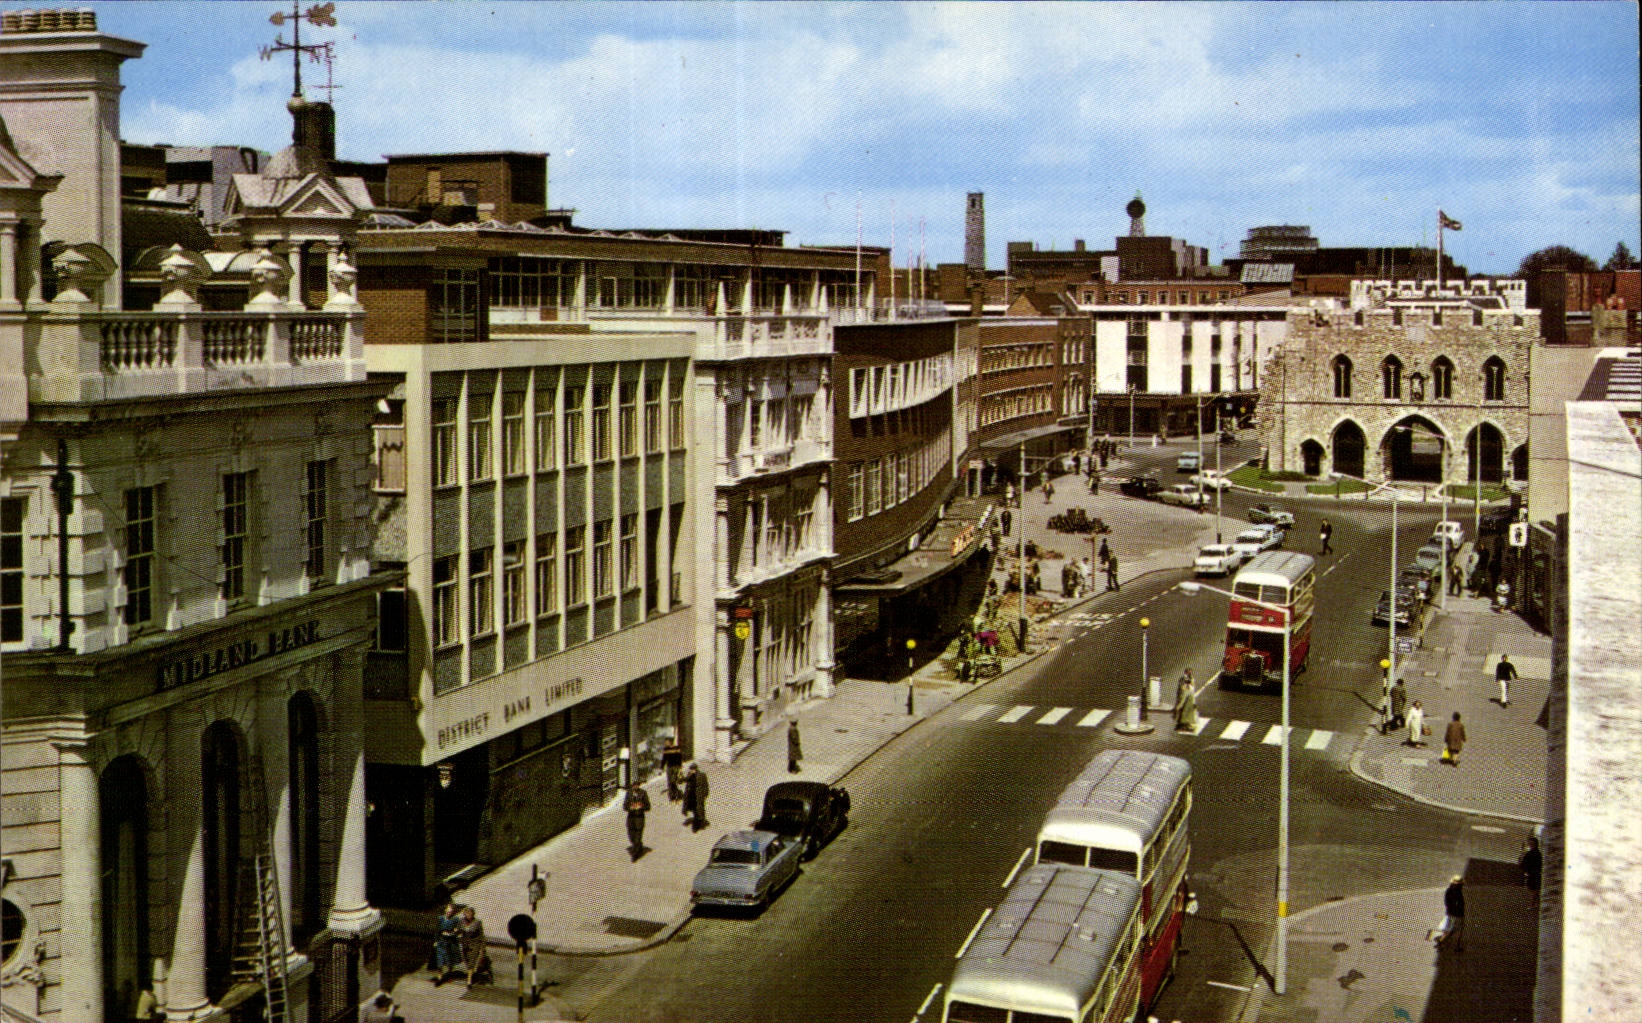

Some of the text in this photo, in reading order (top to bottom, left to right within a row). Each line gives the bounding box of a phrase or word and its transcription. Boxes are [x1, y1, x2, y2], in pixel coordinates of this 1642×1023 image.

[157, 620, 320, 690] MIDLAND BANK
[438, 677, 583, 750] DISTRICT BANK LIMITED
